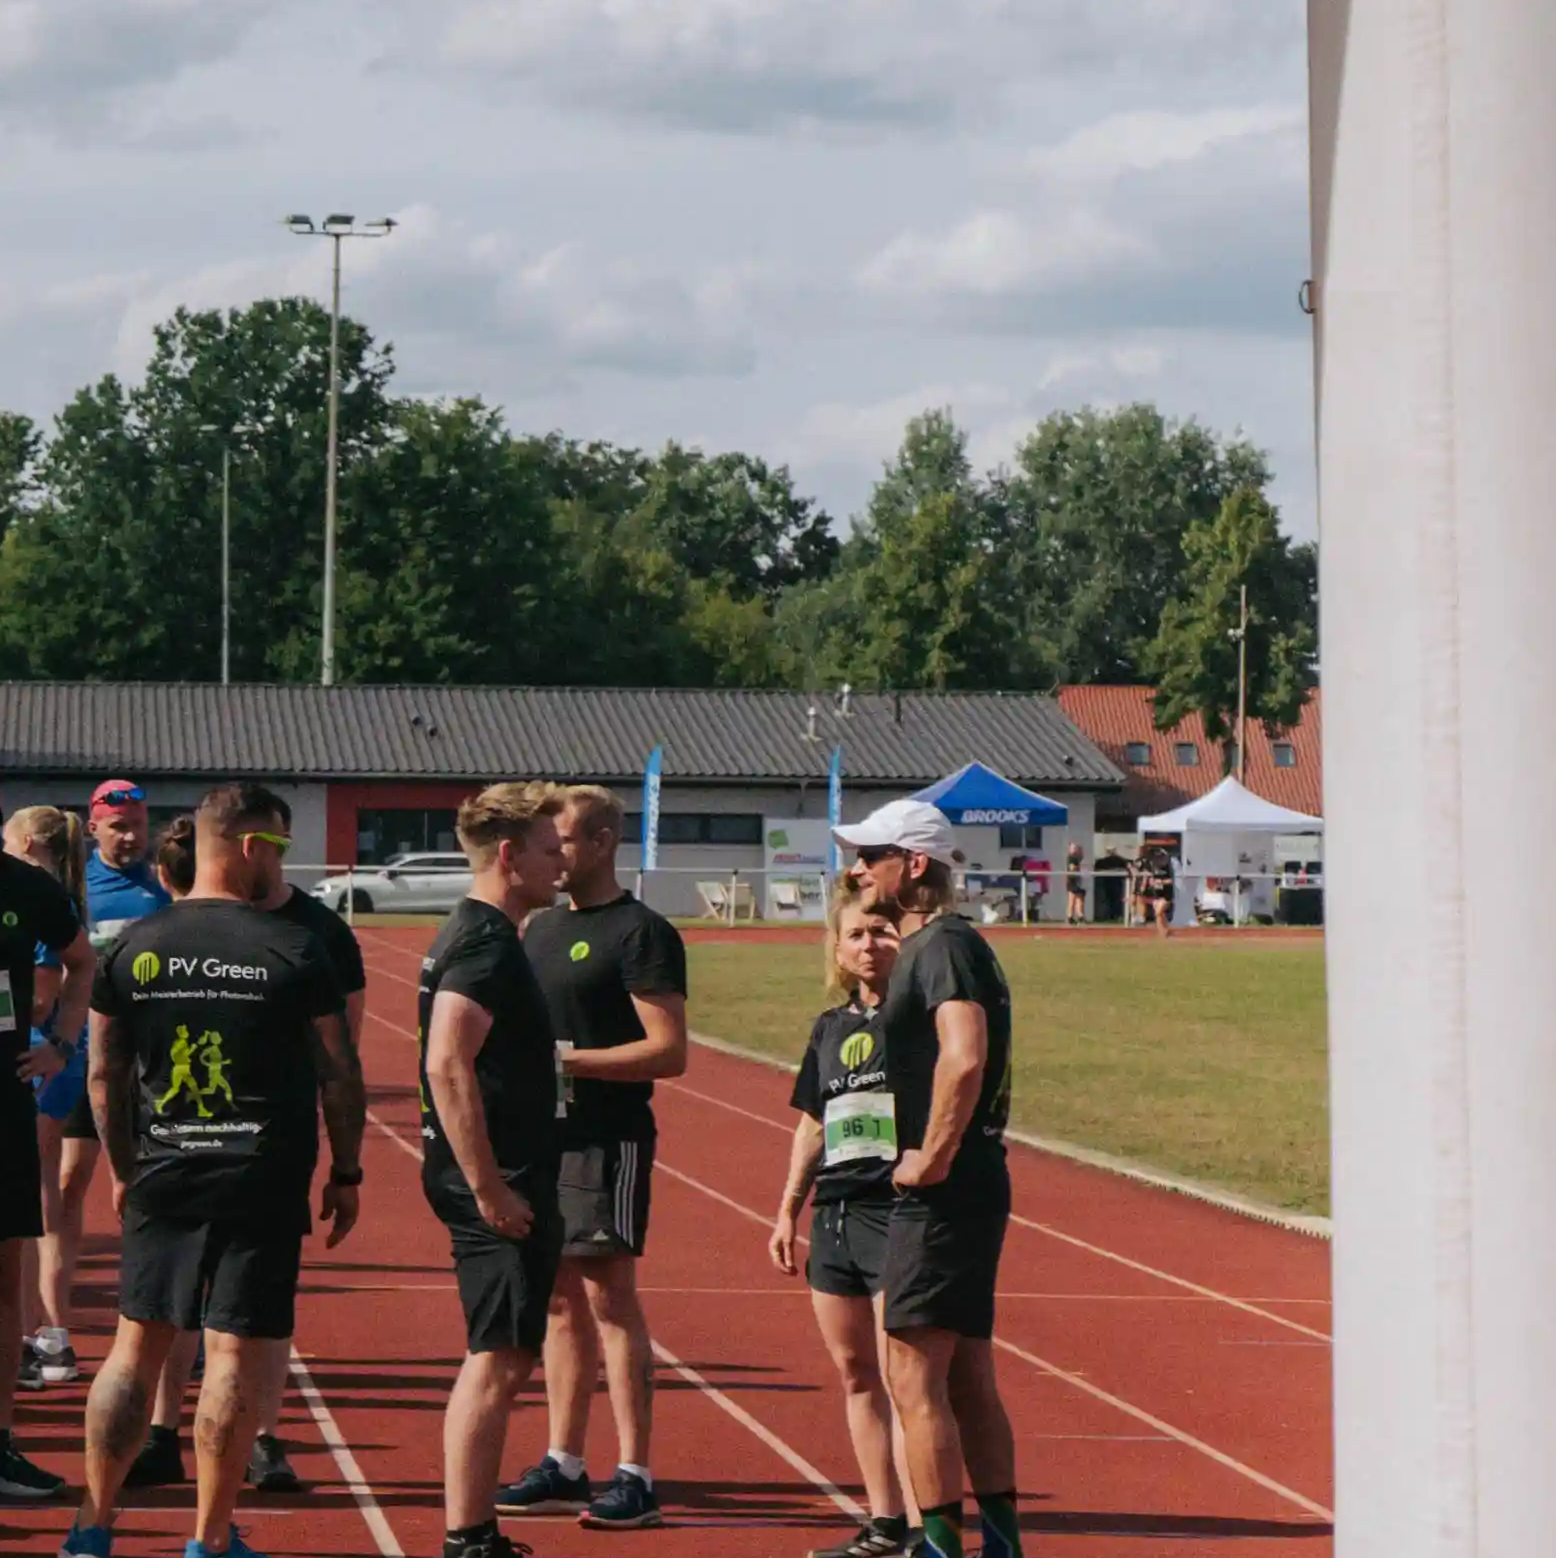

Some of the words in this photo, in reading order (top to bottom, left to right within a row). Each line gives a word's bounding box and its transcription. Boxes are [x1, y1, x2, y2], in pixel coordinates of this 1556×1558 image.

[961, 809, 1031, 824] BROOKS
[169, 957, 198, 978] PV
[202, 958, 268, 981] Green
[848, 1070, 886, 1088] Green
